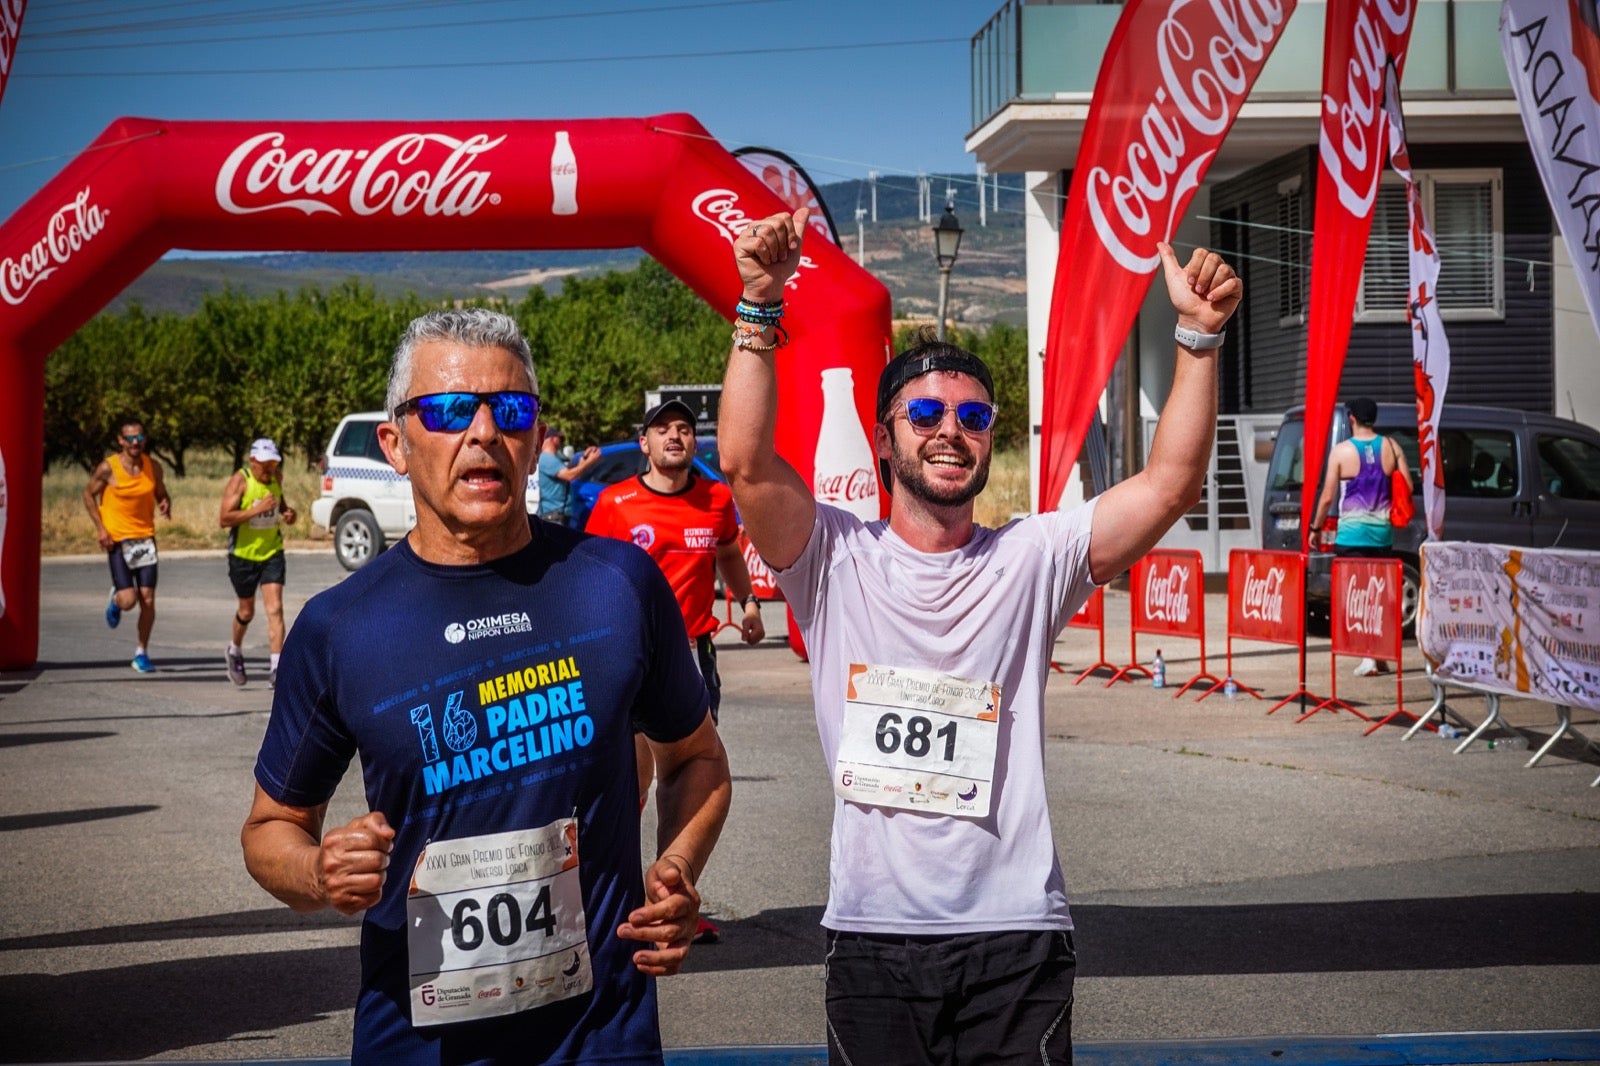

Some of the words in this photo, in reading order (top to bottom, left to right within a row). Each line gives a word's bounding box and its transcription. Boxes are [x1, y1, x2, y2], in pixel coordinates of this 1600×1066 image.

[215, 131, 507, 217] Coca-Cola
[466, 612, 531, 631] OXIMESA
[468, 628, 501, 641] NIPPON
[503, 623, 533, 636] GASES
[478, 656, 581, 706] MEMORIAL
[410, 690, 478, 763] 16
[486, 681, 586, 739] PADRE
[422, 715, 595, 796] MARCELINO
[875, 712, 958, 762] 681
[426, 854, 447, 871] XXXV
[450, 853, 471, 866] GRAN
[473, 848, 503, 863] PREMIO
[505, 846, 516, 860] DE
[518, 842, 545, 857] FONDO
[470, 865, 503, 880] UNIVERSO
[451, 884, 557, 952] 604
[436, 985, 470, 996] Diputación
[444, 993, 471, 1002] Granada
